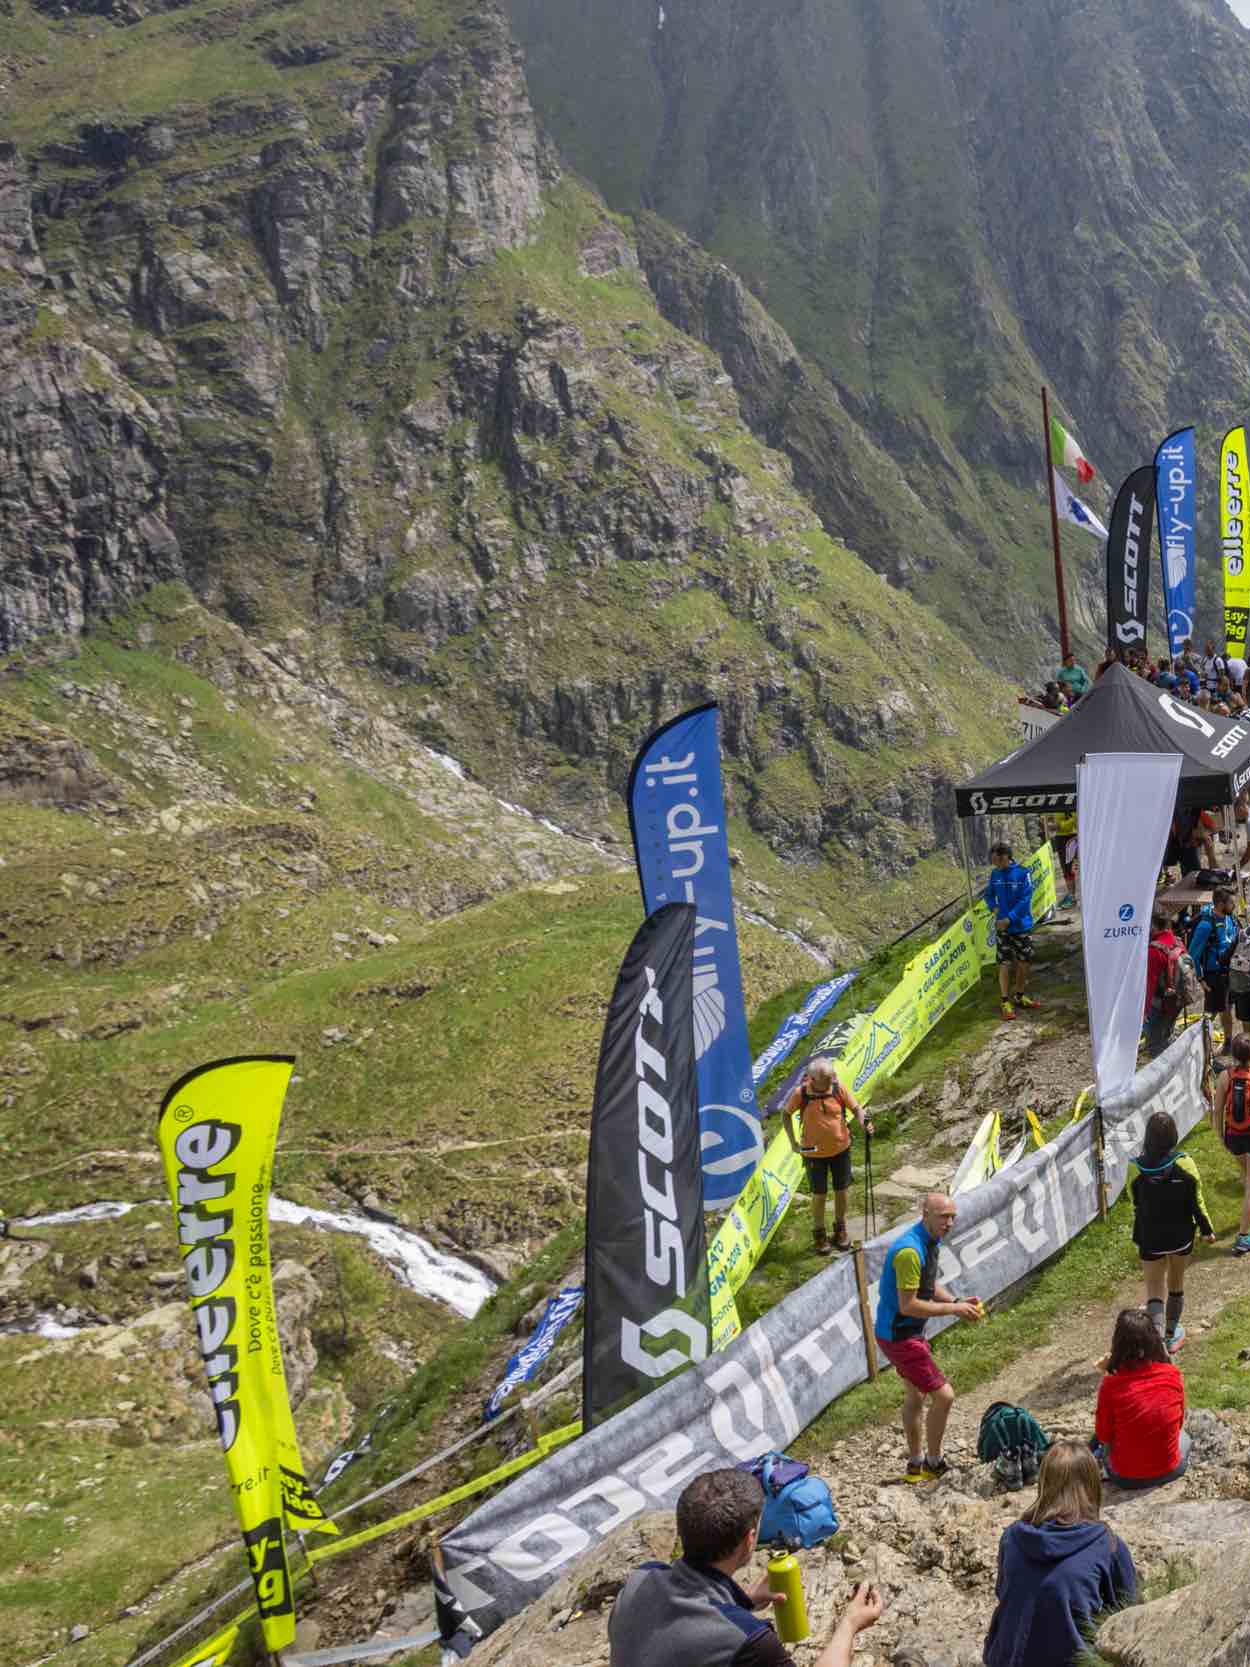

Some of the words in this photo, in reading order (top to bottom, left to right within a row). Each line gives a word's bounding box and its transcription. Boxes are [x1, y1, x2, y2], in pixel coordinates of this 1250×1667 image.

[1162, 446, 1192, 550] fly-up.it
[1223, 451, 1243, 577] elleerre
[1124, 492, 1144, 617] SCOTT
[1211, 725, 1247, 758] SCOTT
[990, 793, 1077, 808] SCOTT
[924, 939, 952, 974] SABATO
[249, 1183, 267, 1267] passione
[245, 1273, 261, 1300] c'è
[247, 1306, 263, 1353] Dove
